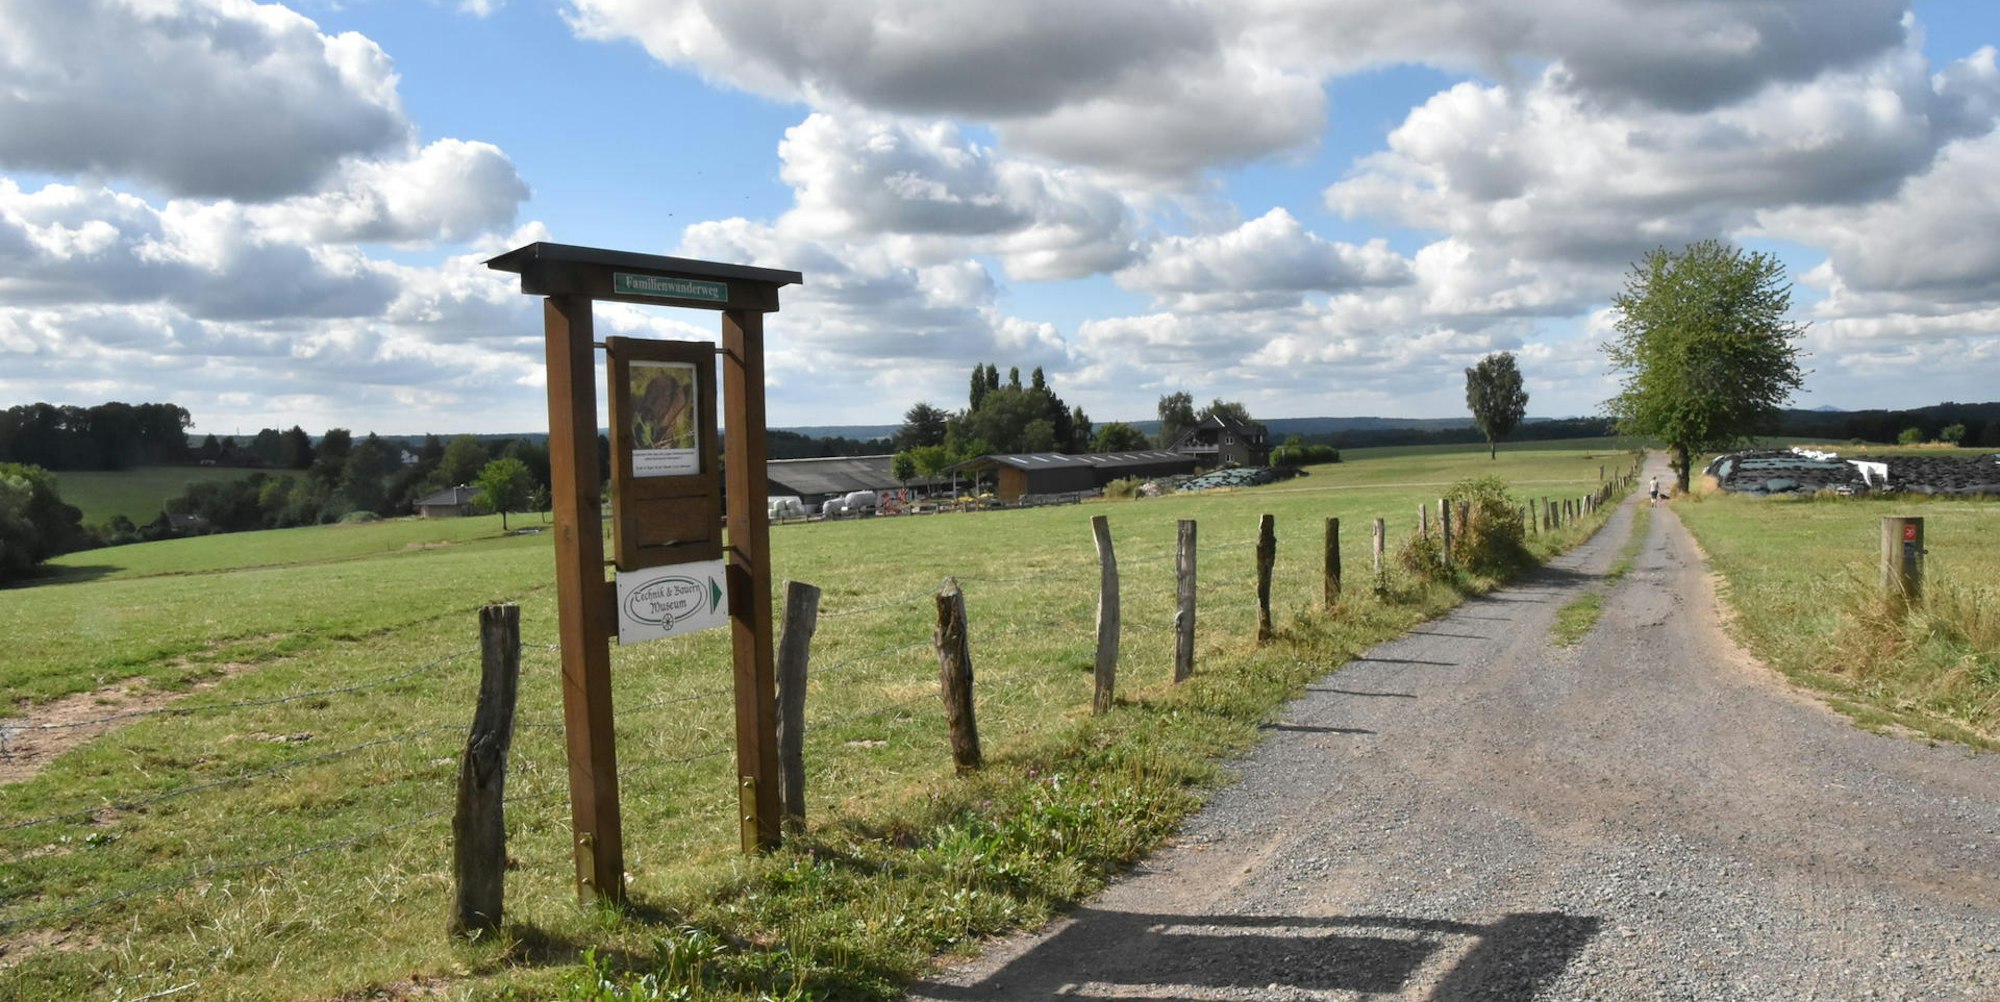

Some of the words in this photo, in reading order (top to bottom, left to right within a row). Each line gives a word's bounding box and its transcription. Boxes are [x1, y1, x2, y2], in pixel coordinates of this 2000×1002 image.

[626, 276, 719, 297] Familienwanderweg
[633, 585, 665, 602] Technik
[666, 586, 673, 597] &
[674, 584, 701, 596] Bauern
[650, 600, 687, 614] Museum
